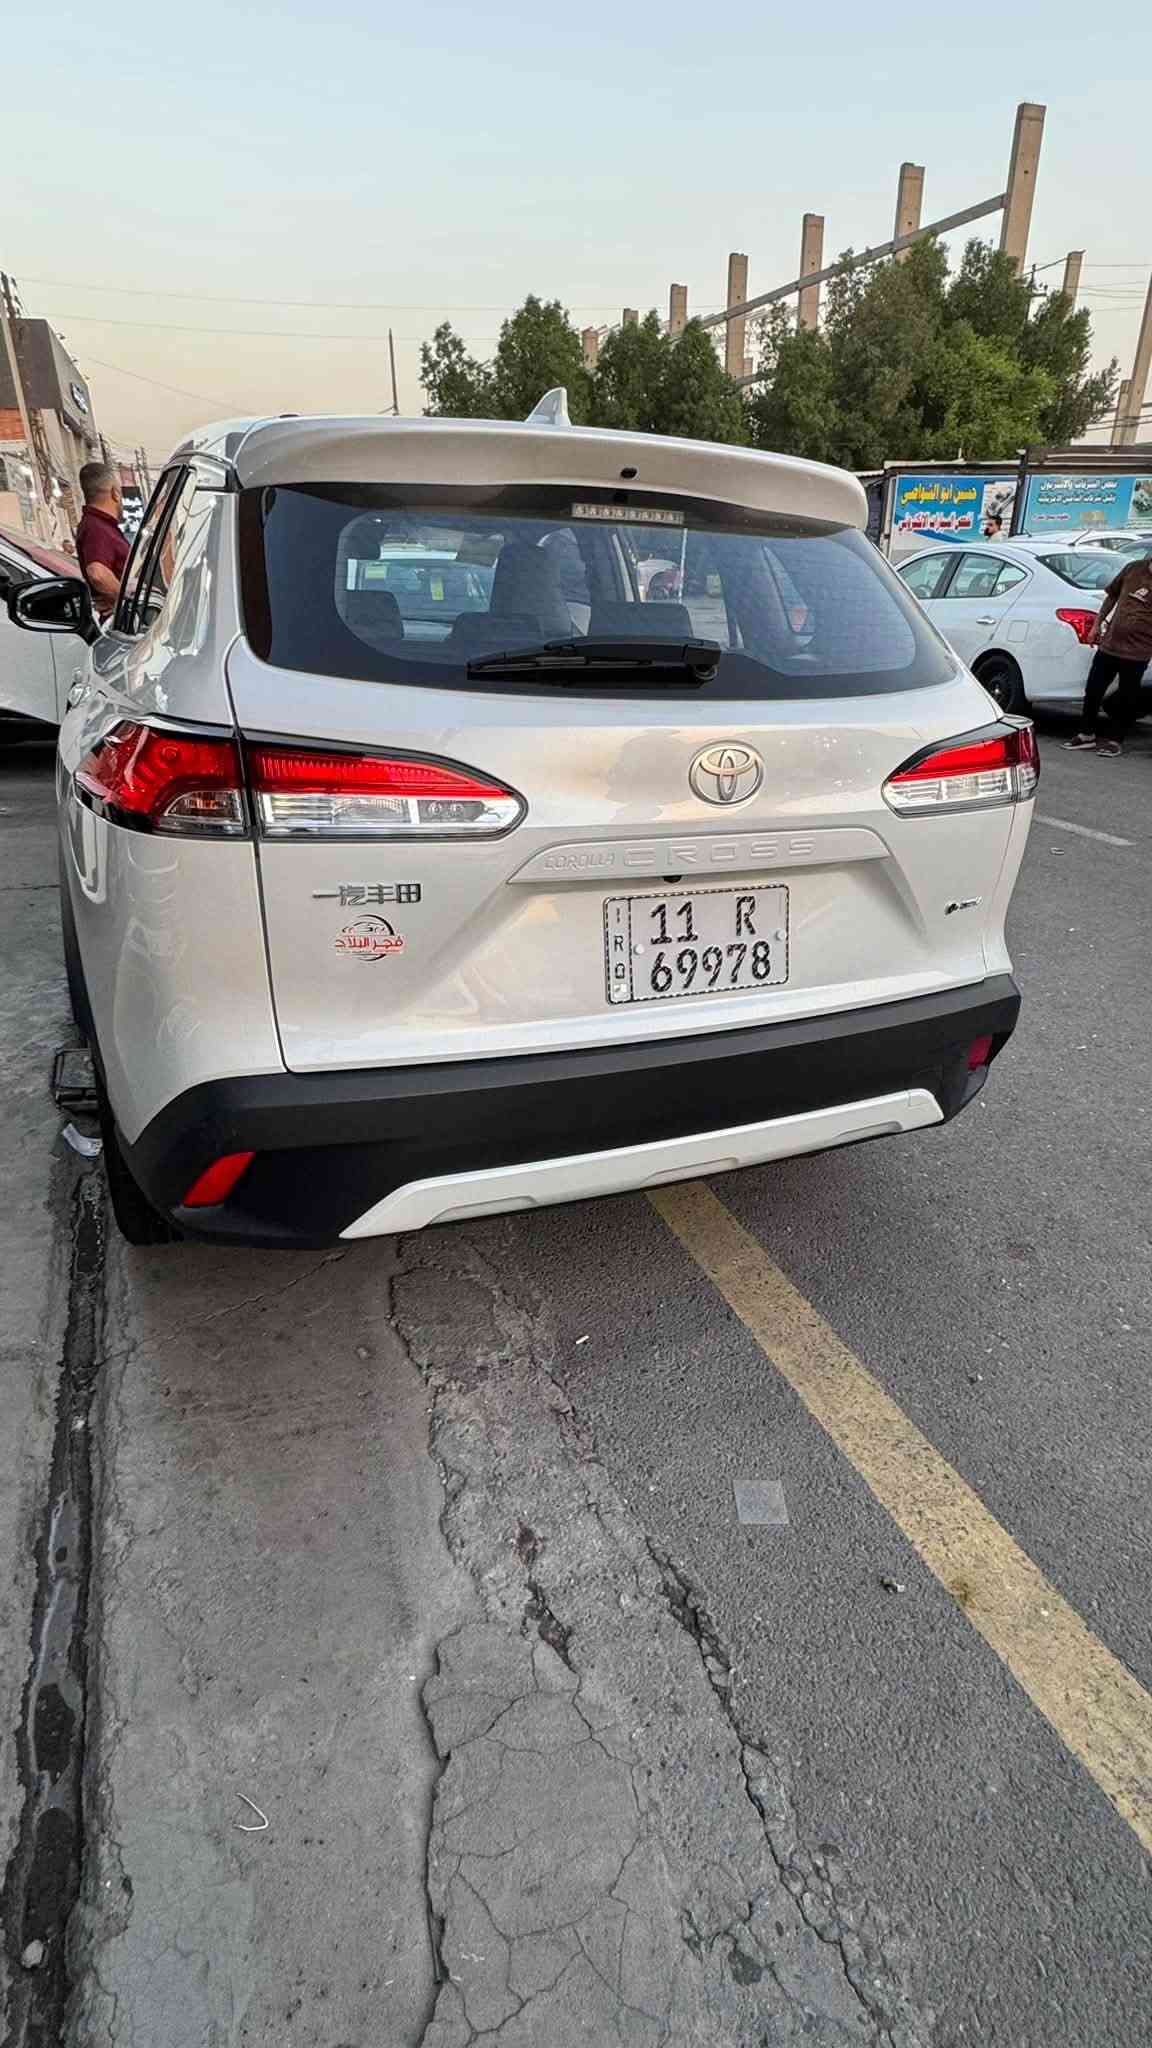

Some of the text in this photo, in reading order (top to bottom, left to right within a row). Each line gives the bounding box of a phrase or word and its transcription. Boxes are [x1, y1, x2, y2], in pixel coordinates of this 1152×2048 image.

[543, 836, 816, 872] COROLLA CROSS
[312, 882, 422, 906] 一汽丰田
[650, 895, 757, 945] 11 R
[650, 940, 771, 993] 69978
